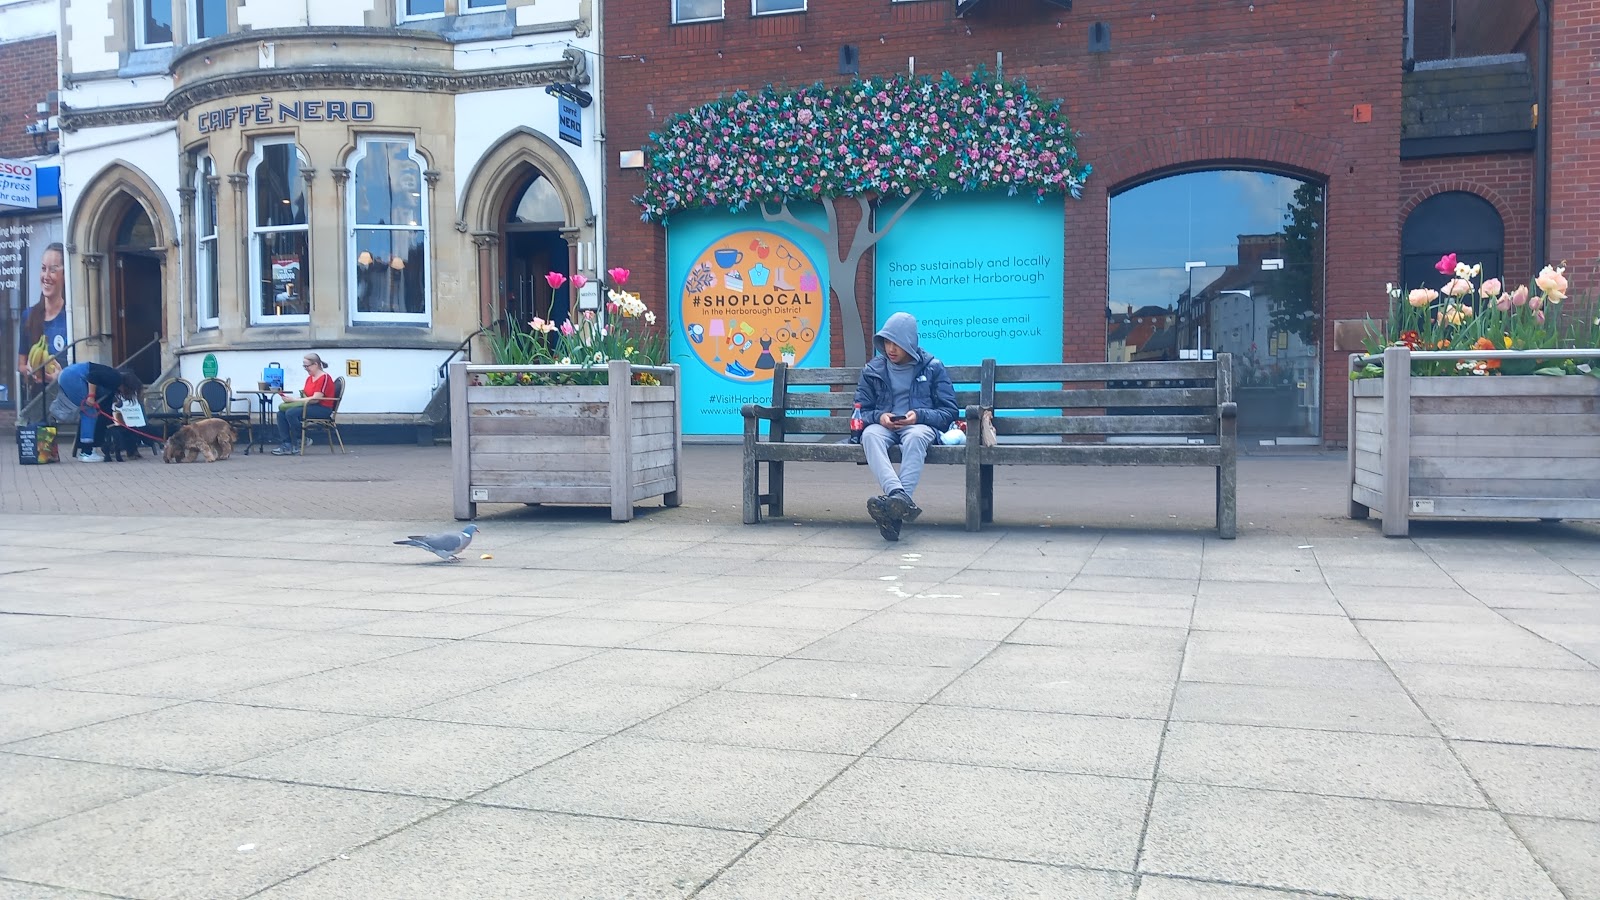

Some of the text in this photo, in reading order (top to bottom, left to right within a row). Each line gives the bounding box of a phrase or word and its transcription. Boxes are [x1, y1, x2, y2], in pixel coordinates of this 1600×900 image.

[198, 96, 375, 133] CAFFÈ NERO
[560, 115, 581, 132] NERO
[11, 194, 31, 204] cash
[9, 224, 34, 236] Market
[17, 253, 22, 261] a
[888, 254, 1051, 274] Shop sustainably and locally
[2, 265, 24, 275] better
[5, 279, 17, 290] day
[888, 270, 1045, 288] here in Market Harborough
[692, 293, 812, 308] #SHOPLOCAL
[711, 308, 724, 316] the
[725, 306, 772, 317] Harborough
[774, 306, 802, 315] District
[921, 316, 964, 328] enquires
[965, 314, 999, 328] please
[1001, 313, 1031, 325] email
[348, 361, 359, 375] H
